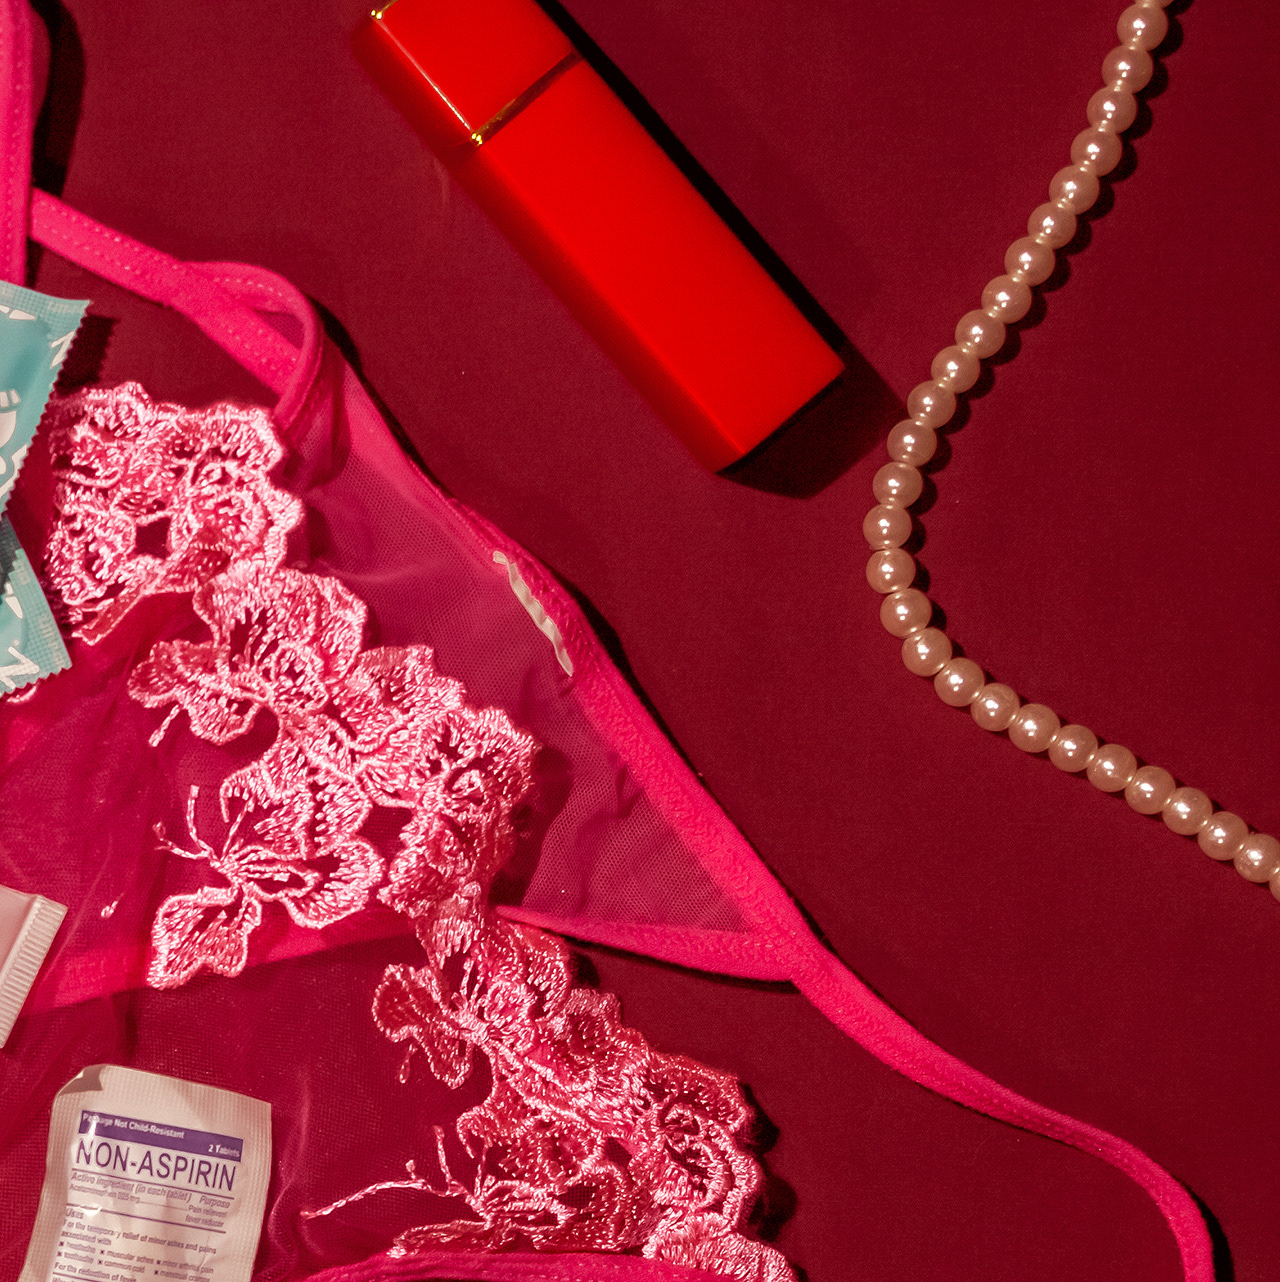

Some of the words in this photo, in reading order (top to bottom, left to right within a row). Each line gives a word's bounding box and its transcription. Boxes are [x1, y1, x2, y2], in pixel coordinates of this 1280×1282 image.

[114, 1119, 127, 1128] Not
[128, 1121, 184, 1139] Child-Resistant
[208, 1144, 213, 1152] 2
[75, 1137, 236, 1191] NON-ASPIRIN
[71, 1171, 95, 1183] Active
[96, 1176, 134, 1192] ingredient
[147, 1185, 166, 1196] each
[198, 1195, 230, 1209] Purpose
[187, 1204, 202, 1213] Pain
[75, 1222, 85, 1230] the
[122, 1231, 139, 1240] relief
[147, 1235, 166, 1245] minor
[167, 1239, 184, 1248] aches
[185, 1242, 197, 1251] and
[198, 1245, 217, 1255] pains
[97, 1237, 111, 1246] with
[54, 1262, 66, 1271] For
[66, 1265, 77, 1273] the
[78, 1267, 110, 1279] reduction
[111, 1273, 119, 1281] of
[104, 1259, 131, 1270] common
[132, 1264, 145, 1273] cold
[106, 1249, 134, 1261] muscular
[162, 1259, 178, 1268] minor
[199, 1265, 214, 1275] pain
